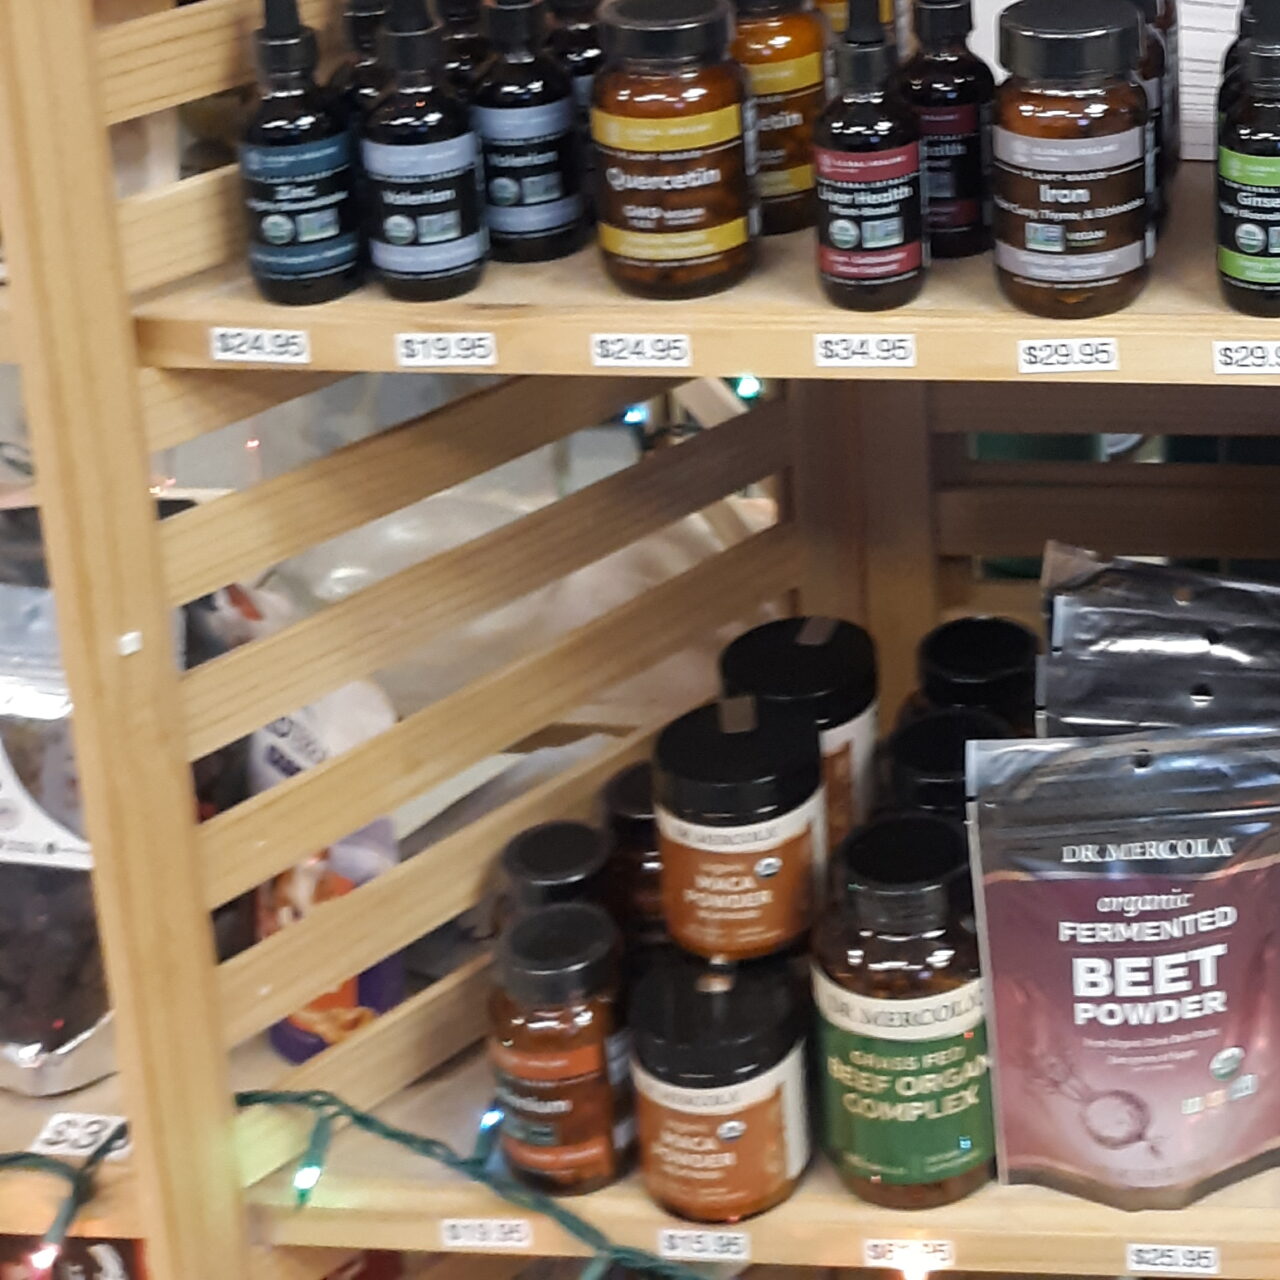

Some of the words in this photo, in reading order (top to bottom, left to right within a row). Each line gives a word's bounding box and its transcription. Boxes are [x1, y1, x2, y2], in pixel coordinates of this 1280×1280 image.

[606, 166, 721, 192] Quercetin
[1039, 184, 1091, 204] Iron
[216, 332, 305, 357] $24.95
[402, 337, 494, 360] $19.95
[596, 338, 687, 362] $24.95
[819, 338, 912, 362] $34.95
[1023, 342, 1116, 366] $29.95
[1104, 837, 1235, 862] MERCOLA
[1097, 888, 1195, 916] organic
[1058, 906, 1238, 943] FERMENTED
[1072, 942, 1228, 998] BEET
[1074, 990, 1228, 1026] POWDER
[842, 1084, 981, 1122] COMPLEX
